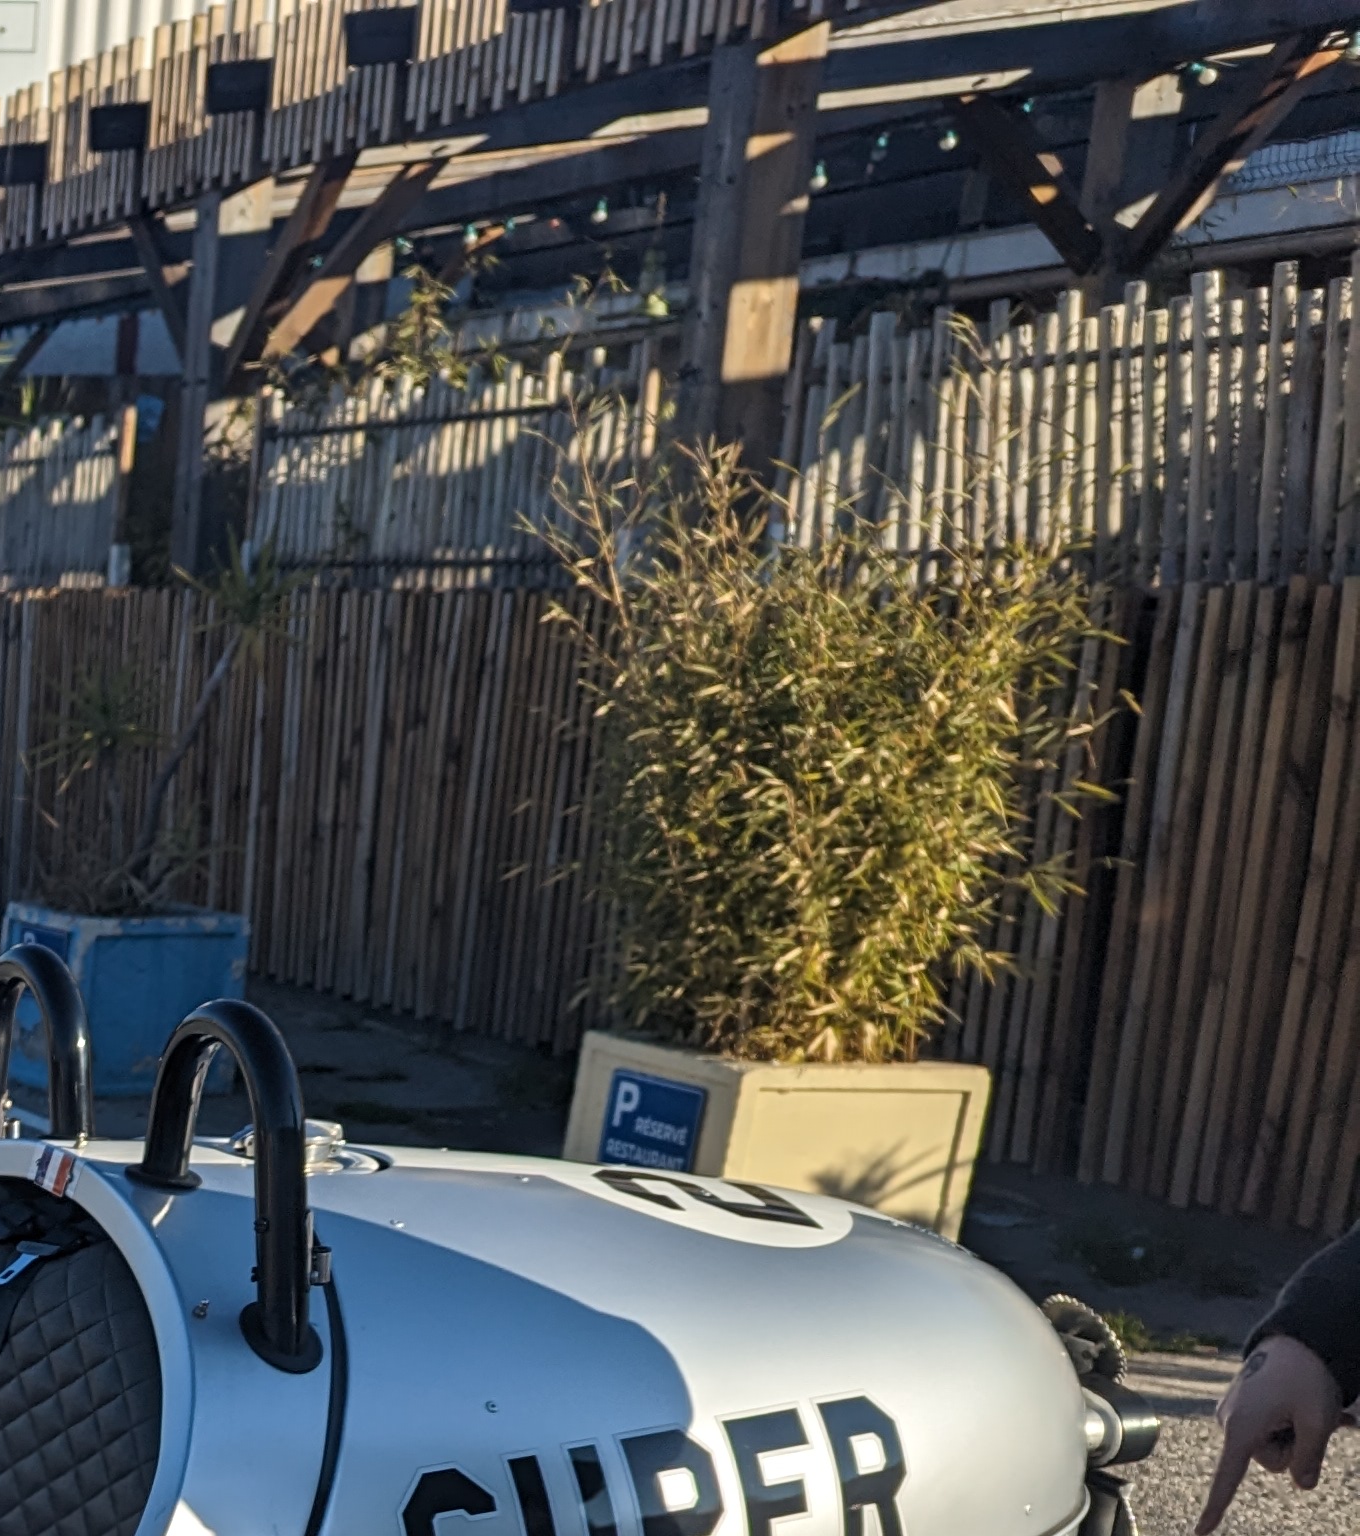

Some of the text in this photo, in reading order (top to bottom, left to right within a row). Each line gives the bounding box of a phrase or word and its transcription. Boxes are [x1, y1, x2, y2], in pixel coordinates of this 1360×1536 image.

[611, 1080, 642, 1128] P
[634, 1114, 688, 1146] RÉSERVÉ
[605, 1138, 685, 1170] RESTAURANT
